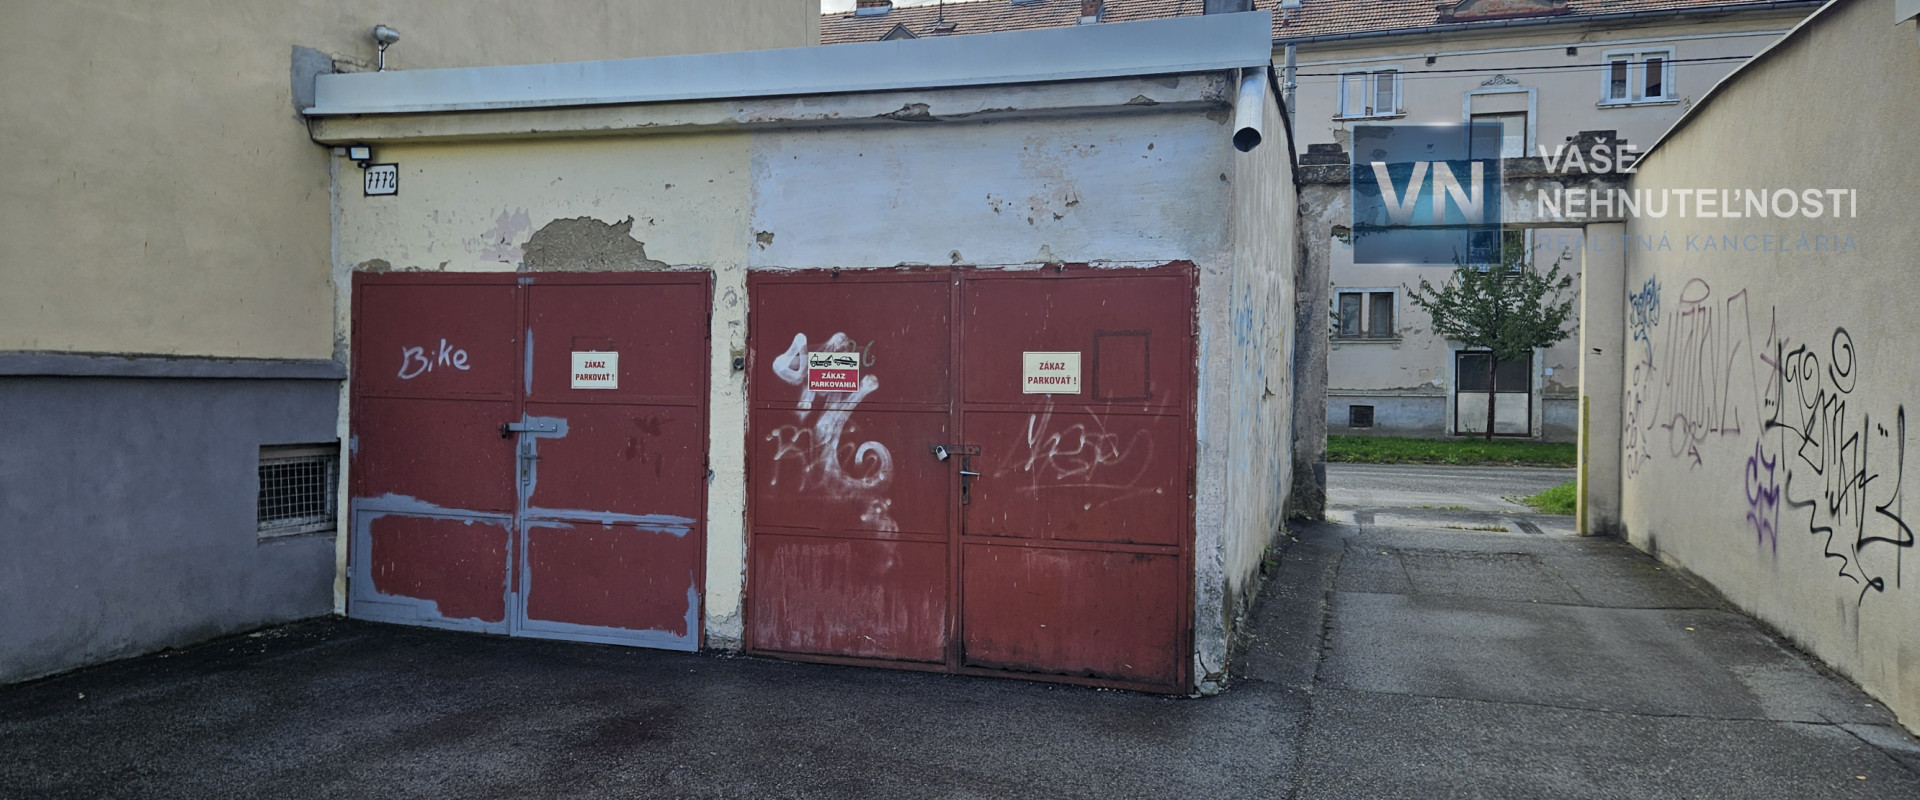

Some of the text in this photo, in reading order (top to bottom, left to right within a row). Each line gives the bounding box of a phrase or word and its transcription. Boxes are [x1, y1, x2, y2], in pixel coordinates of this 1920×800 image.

[367, 171, 395, 189] 7772
[397, 338, 470, 380] Bike
[584, 360, 606, 369] ZÁKAZ
[1039, 361, 1066, 370] ZÁKAZ
